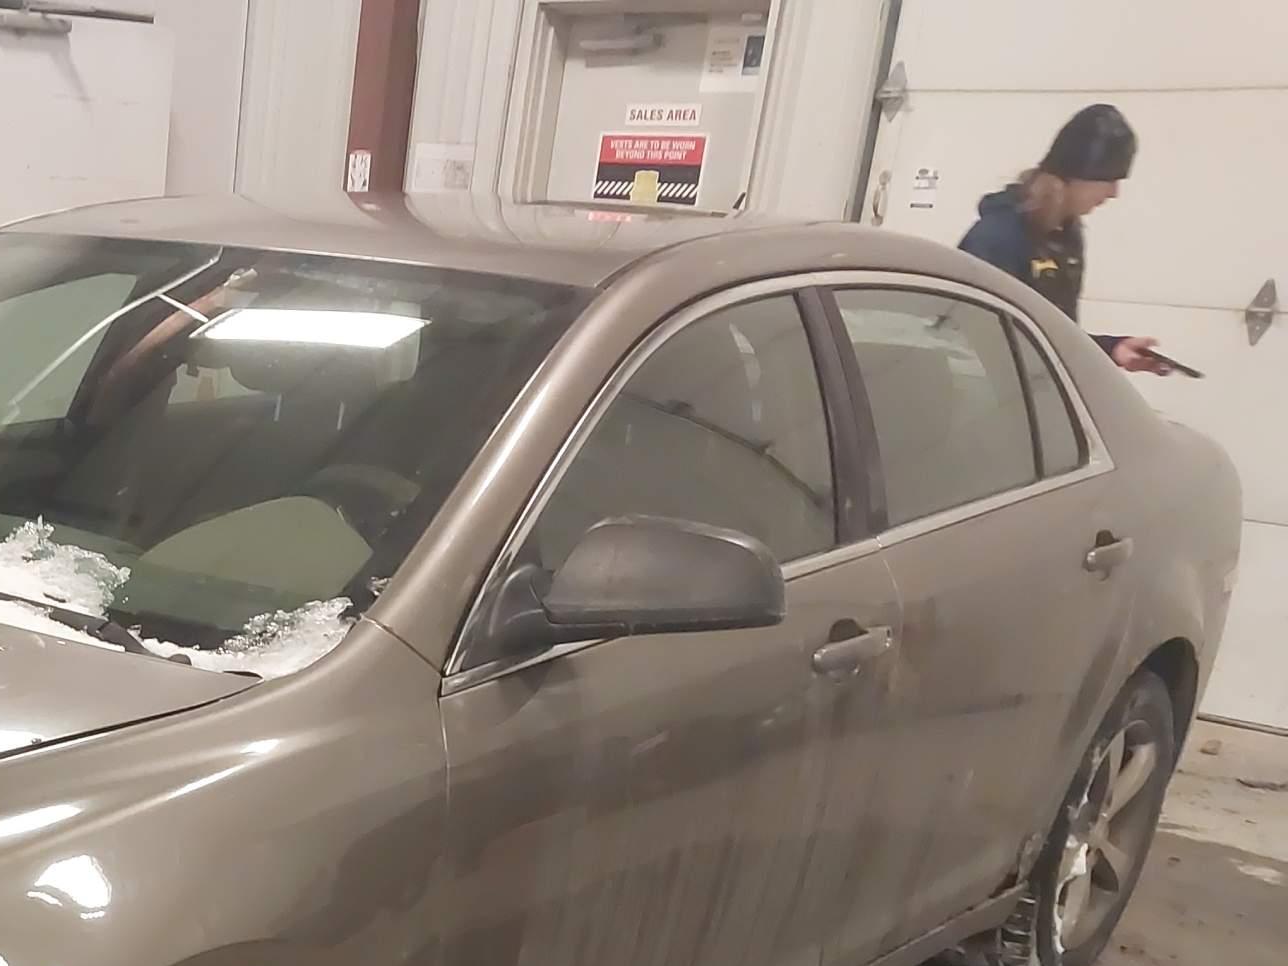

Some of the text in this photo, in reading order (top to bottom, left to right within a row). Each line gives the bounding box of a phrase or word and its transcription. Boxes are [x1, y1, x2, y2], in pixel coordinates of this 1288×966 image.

[629, 108, 697, 121] SALES AREA
[633, 139, 648, 150] ARE
[650, 139, 659, 150] TO
[615, 149, 687, 161] BEYOND THIS POINT
